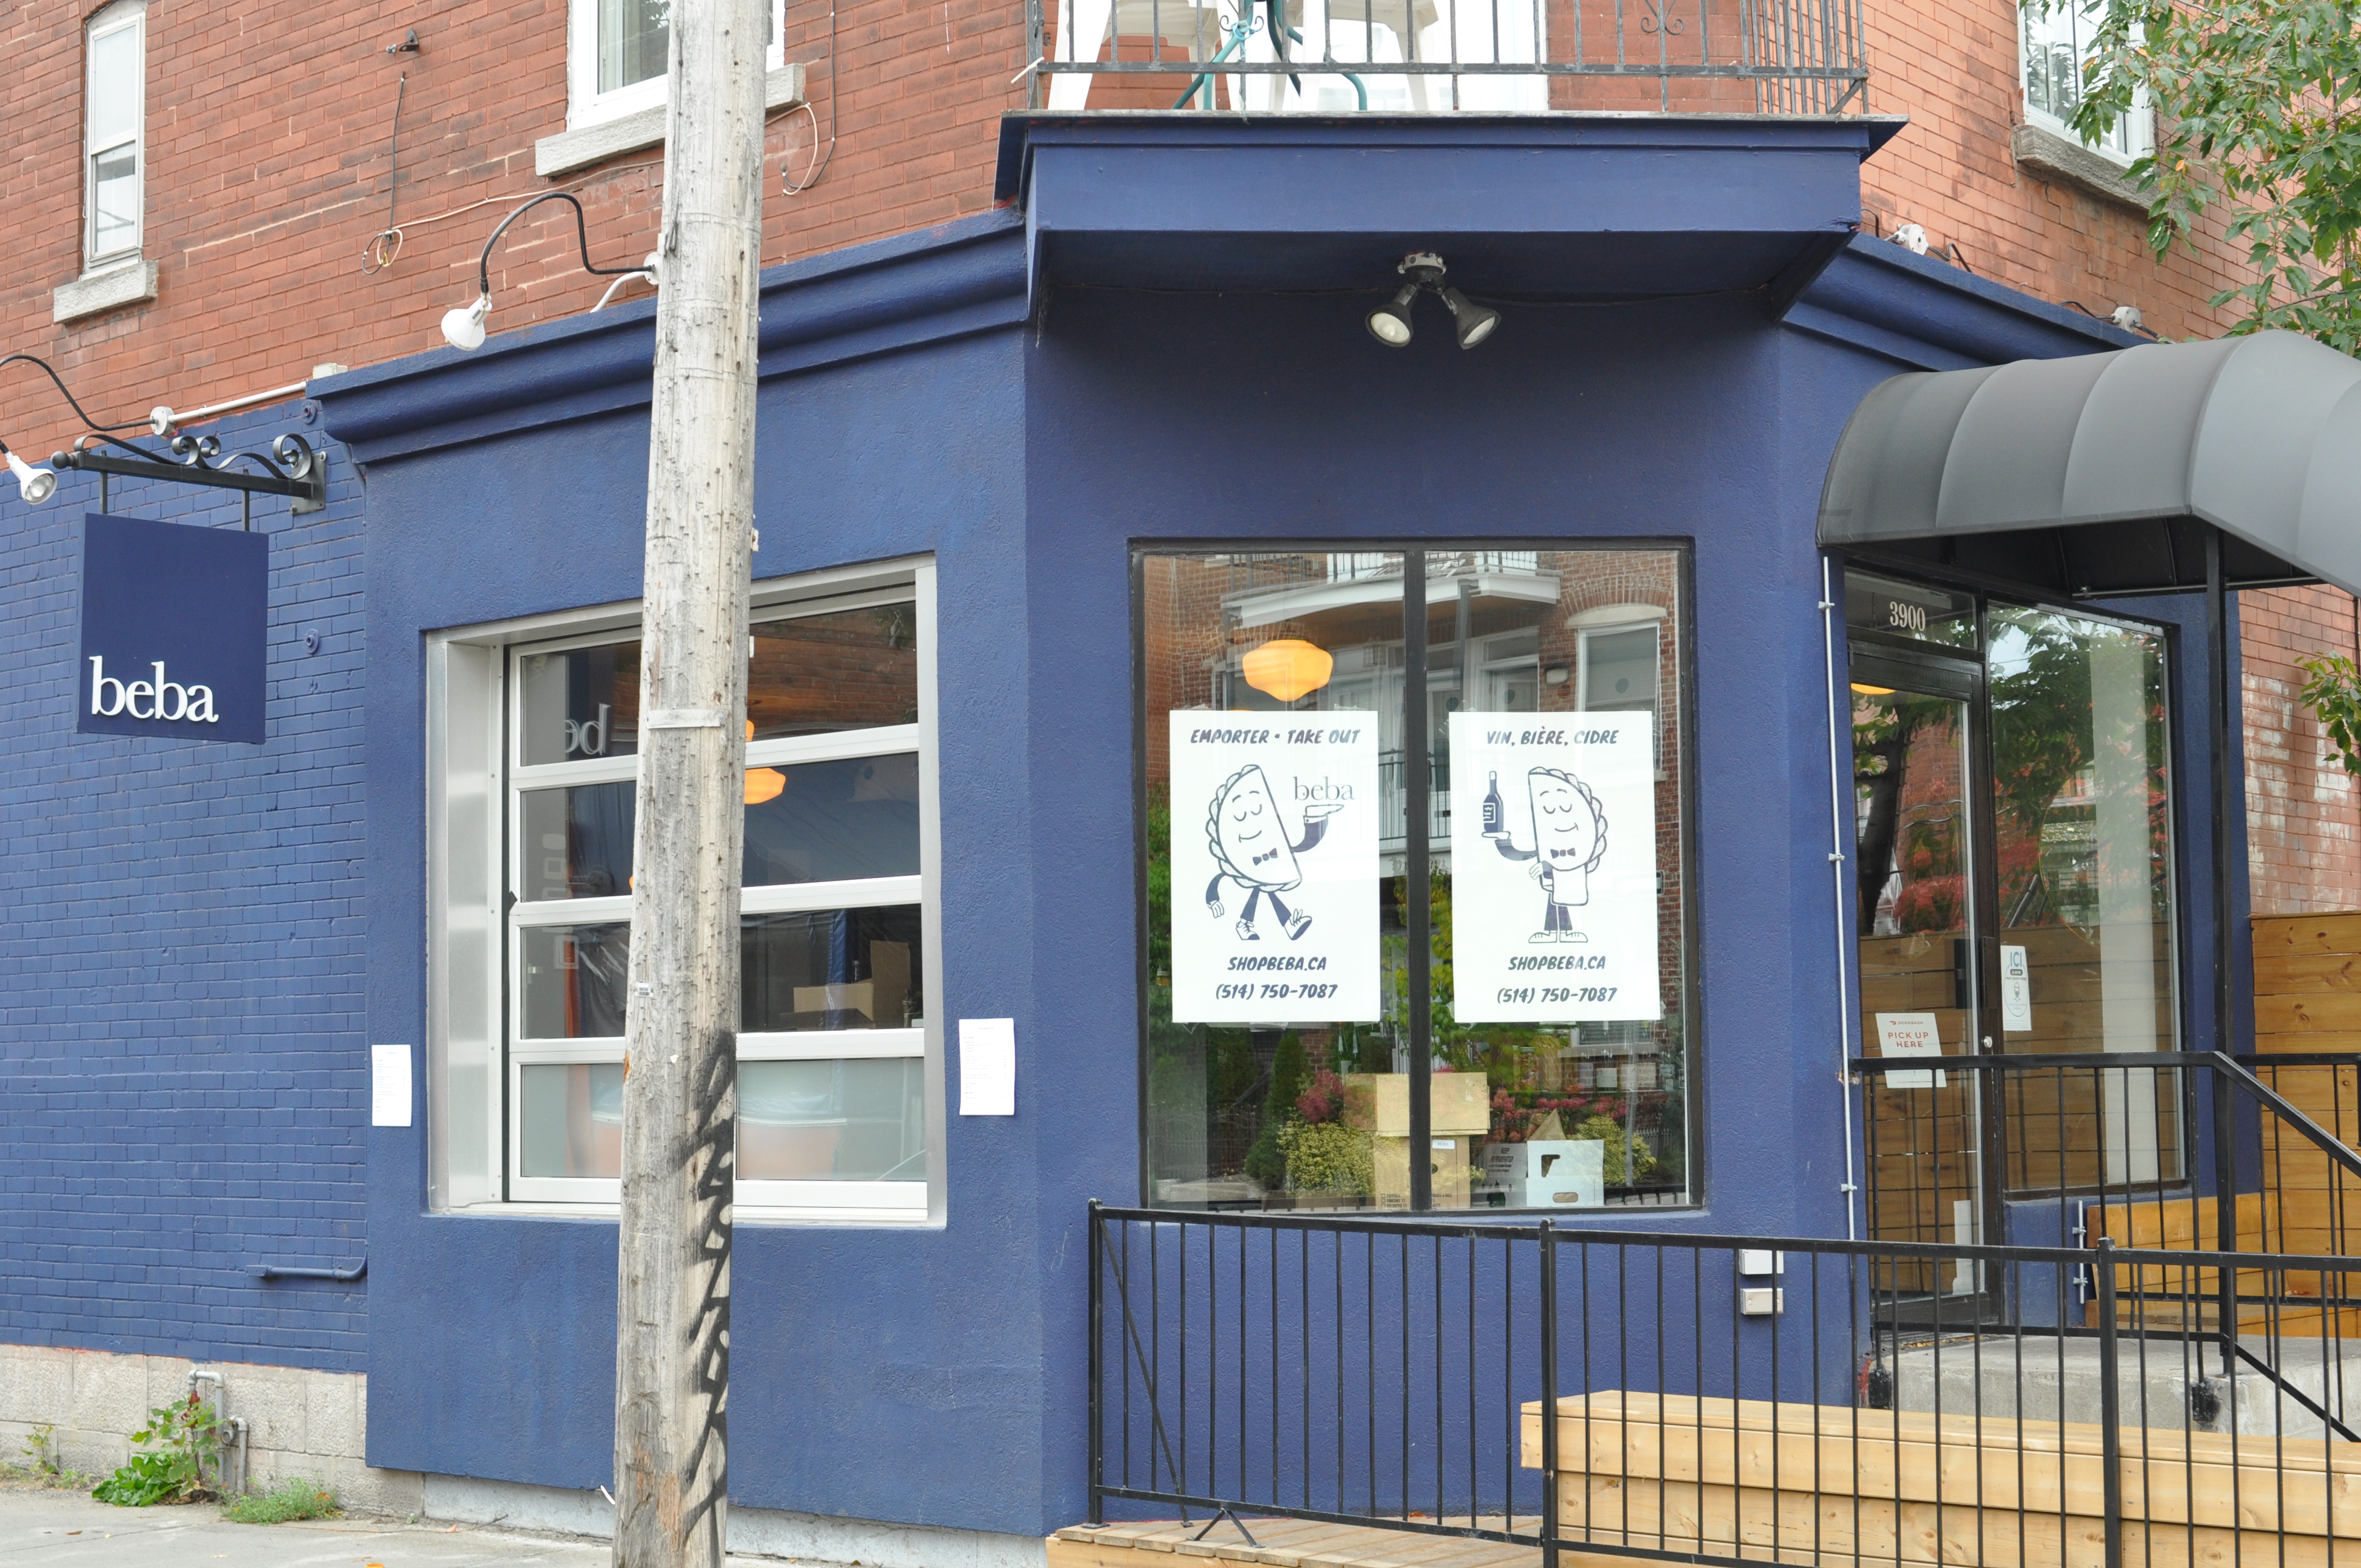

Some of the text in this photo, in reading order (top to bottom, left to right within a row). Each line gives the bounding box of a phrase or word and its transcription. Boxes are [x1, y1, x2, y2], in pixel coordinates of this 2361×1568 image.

[1889, 601, 1926, 632] 3900
[88, 655, 220, 723] beba
[1190, 728, 1361, 744] EMPORTER TAKE OUT
[1487, 725, 1620, 747] VIN, BIÈRE, CIDRE
[1292, 776, 1356, 801] beba
[1227, 956, 1328, 972] SHOPBEBA.CA
[1508, 955, 1607, 971] SHOPBEBA.CA
[2010, 951, 2022, 967] ICI
[1215, 983, 1339, 1000] (514) 750-7087
[1497, 987, 1618, 1005] (514) 750-7087
